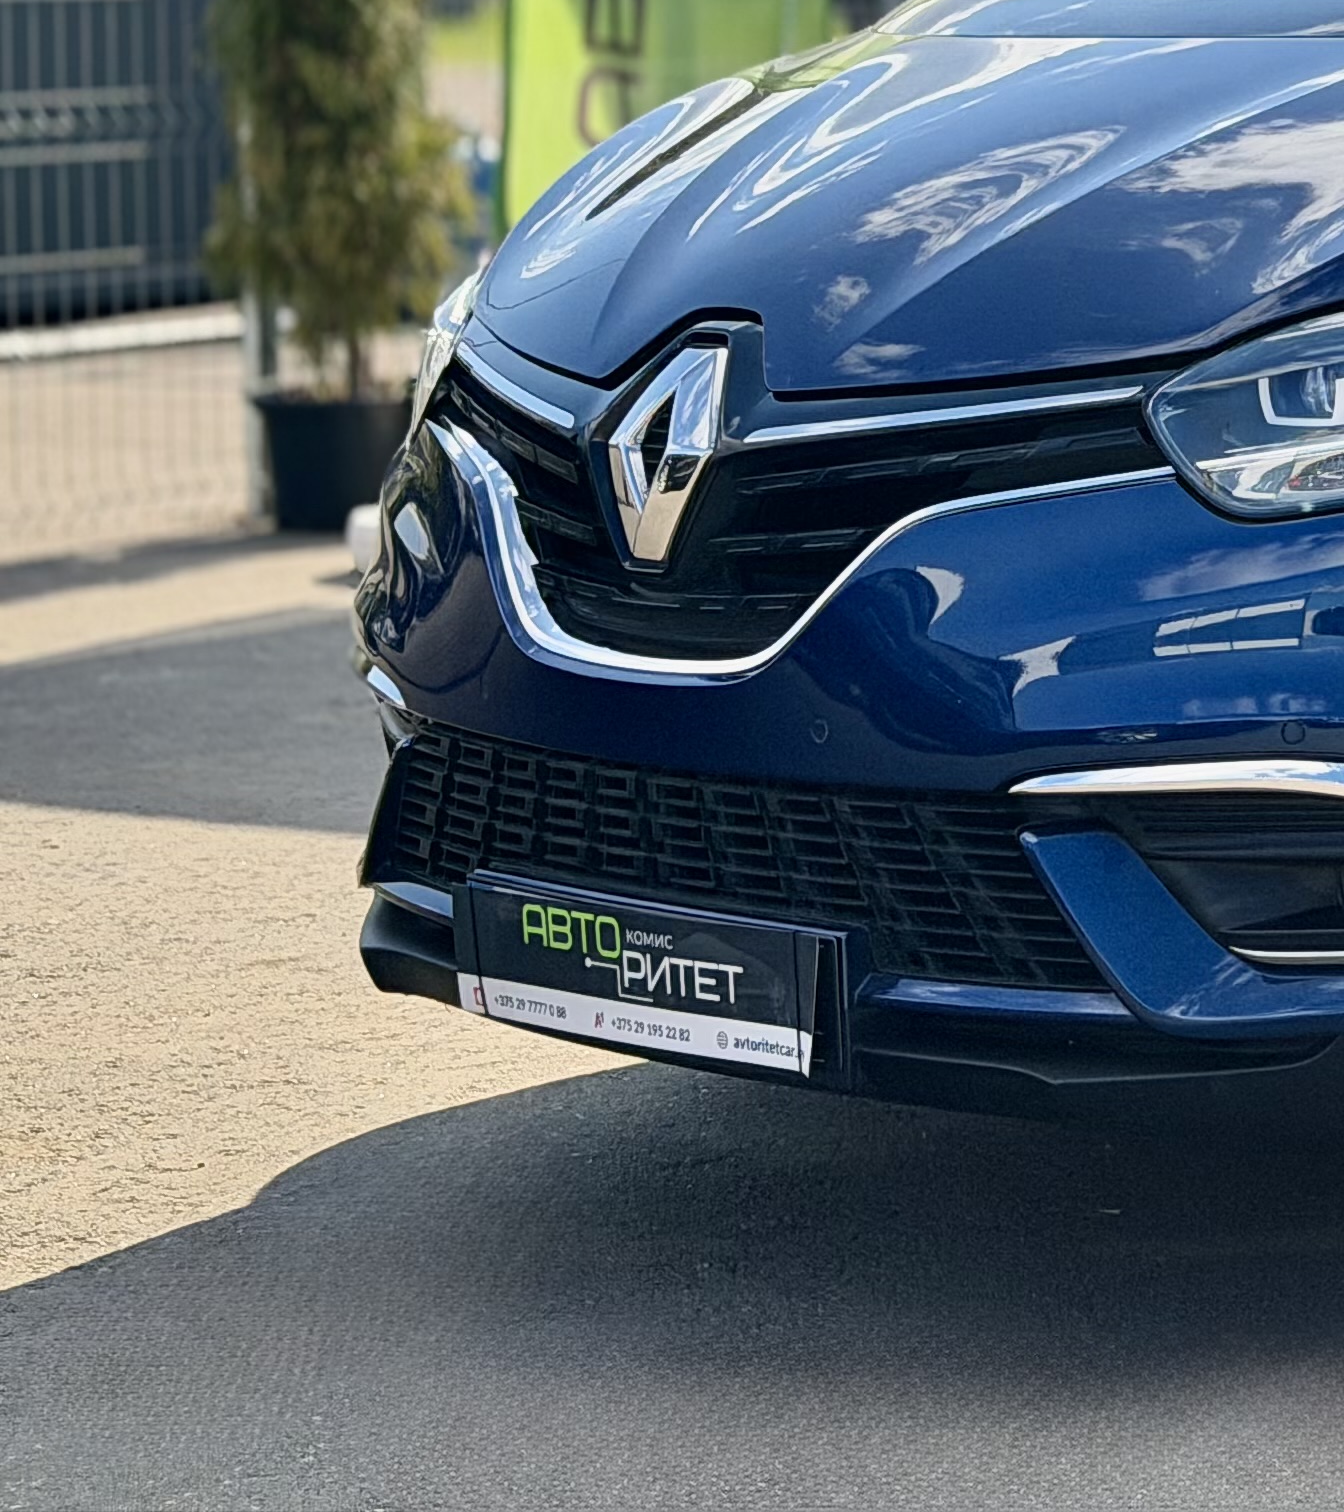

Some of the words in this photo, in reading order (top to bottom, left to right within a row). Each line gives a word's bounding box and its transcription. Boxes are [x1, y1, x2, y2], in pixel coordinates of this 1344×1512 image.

[522, 903, 621, 959] АВТО
[622, 949, 744, 1005] РИТЕТ
[494, 994, 515, 1009] +375
[515, 997, 526, 1011] 29
[611, 1016, 632, 1032] +375
[633, 1020, 645, 1035] 29
[647, 1023, 663, 1038] 195
[665, 1025, 677, 1041] 22
[678, 1028, 691, 1042] 82
